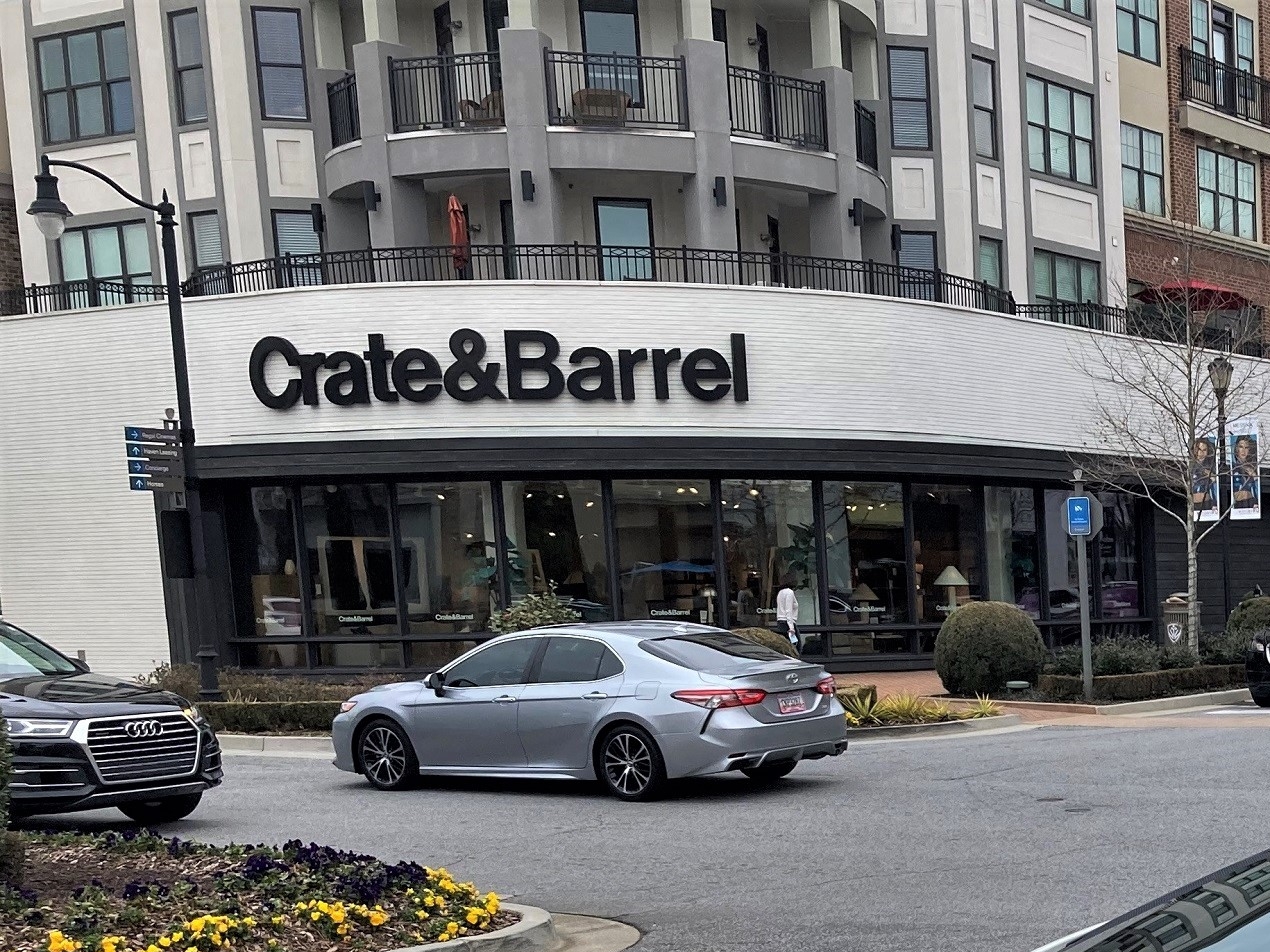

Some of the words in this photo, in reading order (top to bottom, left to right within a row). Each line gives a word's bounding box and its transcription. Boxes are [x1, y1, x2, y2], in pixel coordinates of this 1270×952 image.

[249, 328, 749, 409] Crate&Barrel
[338, 615, 373, 623] Crate&Barrel
[435, 613, 474, 621] Crate&Barrel
